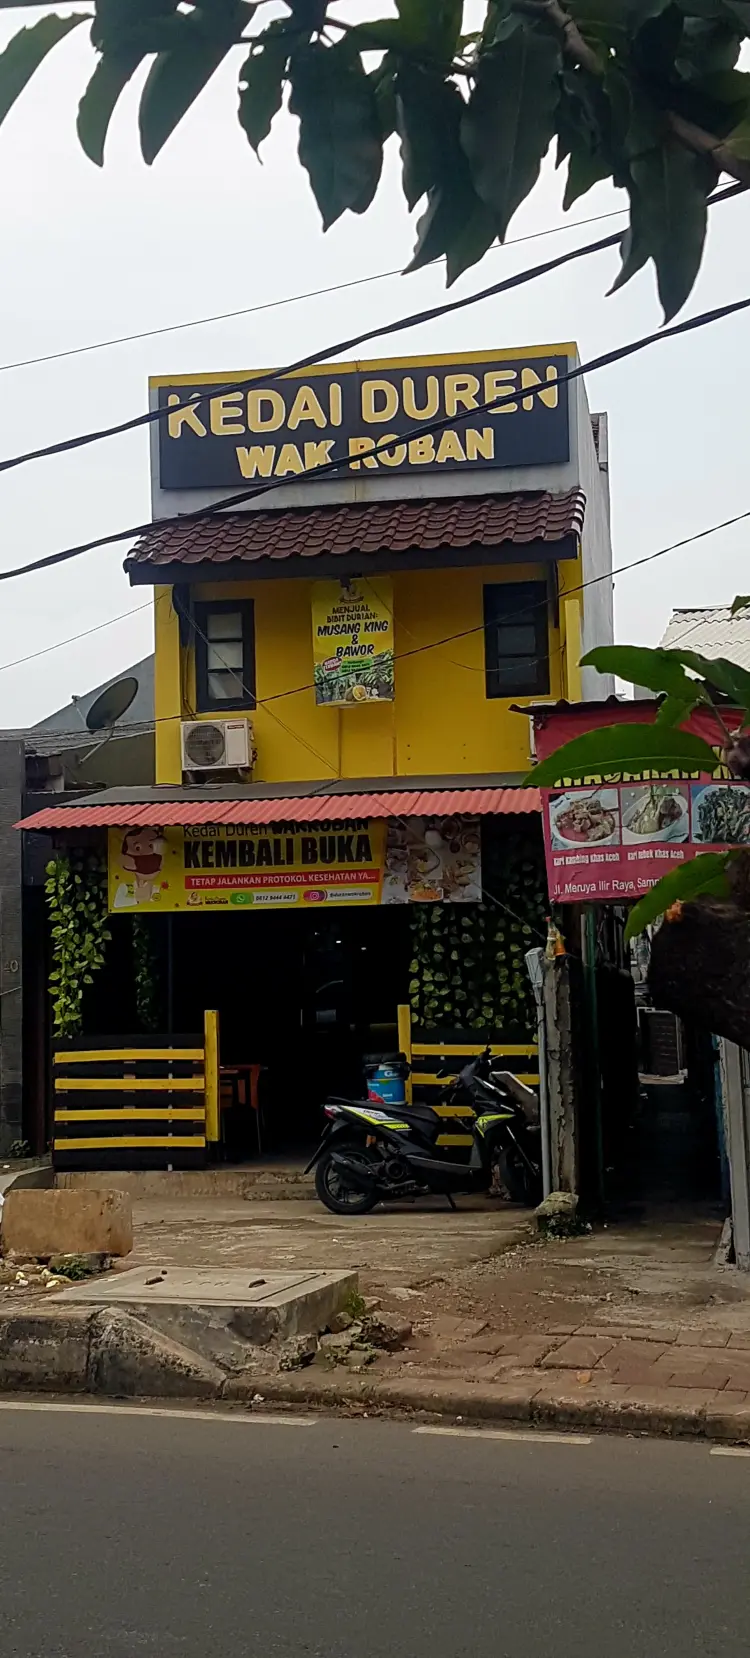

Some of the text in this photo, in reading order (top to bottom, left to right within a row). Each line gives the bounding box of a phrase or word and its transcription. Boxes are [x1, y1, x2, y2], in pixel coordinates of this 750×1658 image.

[167, 364, 559, 439] KEDAI DUREN
[236, 426, 496, 479] WAK ROBAN
[333, 604, 370, 614] MENJUAL
[326, 612, 378, 623] BIBIT DURIAN:
[317, 620, 389, 636] MUSANG KING
[351, 634, 358, 644] &
[336, 644, 375, 657] BAWOR
[183, 824, 220, 837] Kedai
[225, 822, 267, 837] Duren
[184, 834, 372, 868] KEMBALI BUKA
[191, 878, 216, 886] TETAP
[217, 875, 261, 885] JALANKAN
[263, 873, 307, 883] PROTOKOL
[309, 871, 357, 882] KESEHATAN
[564, 882, 596, 895] Meruya
[599, 880, 610, 891] Ilir
[612, 878, 635, 891] Raya,
